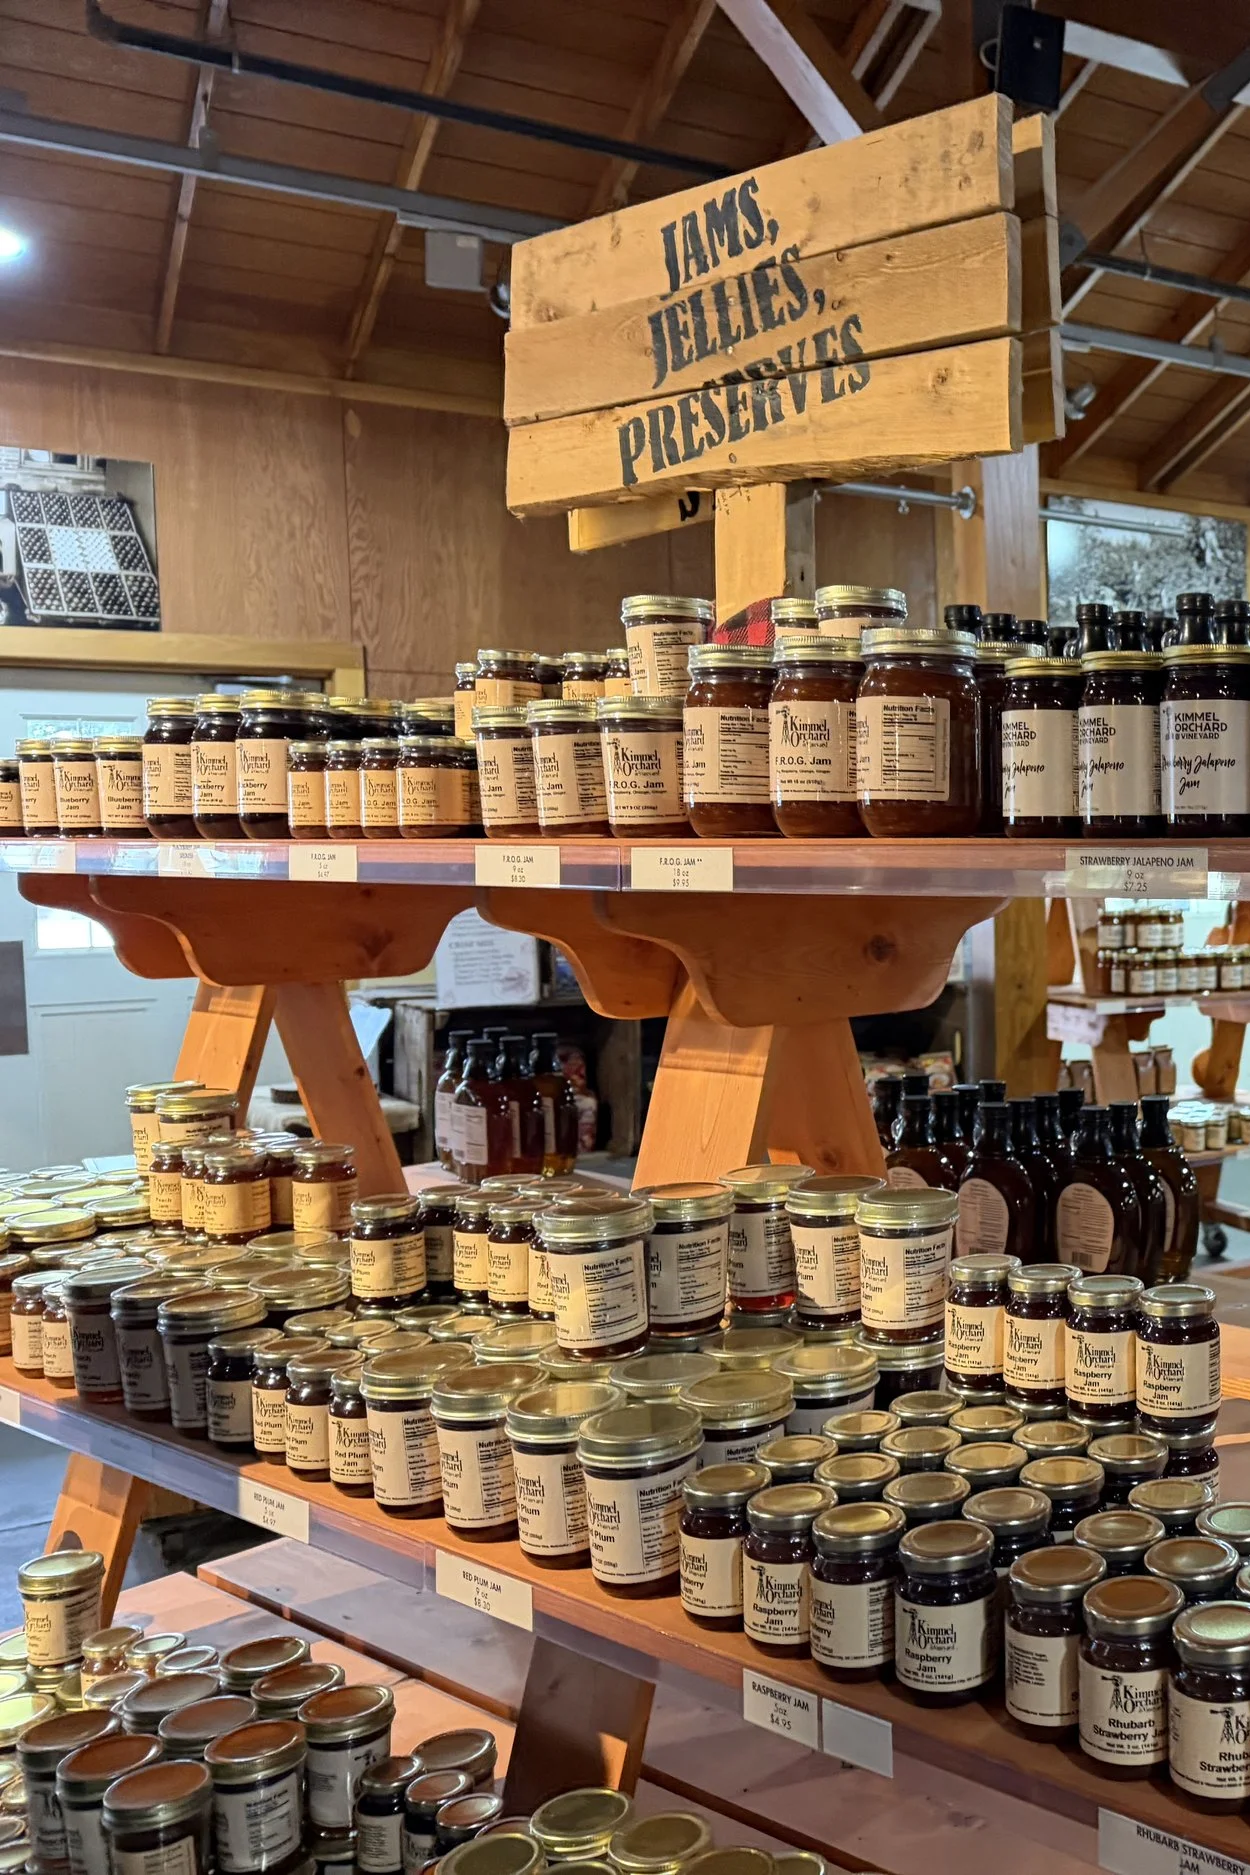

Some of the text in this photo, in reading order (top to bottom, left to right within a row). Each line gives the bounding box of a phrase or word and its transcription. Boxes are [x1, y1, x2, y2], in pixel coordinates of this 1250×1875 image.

[660, 177, 779, 292] JAMS,
[647, 244, 826, 389] JELLIES,
[617, 314, 871, 486] PRESERVES
[883, 704, 913, 712] Nutrition
[720, 714, 750, 722] Nutrition
[790, 716, 827, 731] Kimmel
[1175, 712, 1220, 722] KIMMEL
[1175, 723, 1228, 733] ORCHARD
[790, 729, 829, 747] Orchard
[622, 748, 658, 762] Kimmel
[810, 757, 831, 765] Jam
[623, 759, 661, 776] Orchard
[1194, 753, 1236, 774] Jalapeno
[1179, 777, 1200, 795] Jam
[659, 858, 682, 866] F.R.O.G.
[1080, 857, 1194, 867] STRAWBERRY JALAPENO JAM
[1124, 882, 1148, 892] $7.25
[678, 1242, 706, 1250] Nutrition
[905, 1246, 932, 1255] Nutrition
[584, 1256, 633, 1272] Nutrition Facts
[866, 1283, 883, 1293] Plum
[957, 1317, 982, 1330] Kimmel
[957, 1328, 984, 1341] Orchard
[1014, 1328, 1040, 1342] Kimmel
[1014, 1340, 1042, 1353] Orchard
[1084, 1343, 1114, 1356] Kimmel
[1085, 1354, 1115, 1368] Orchard
[1153, 1355, 1182, 1368] Kimmel
[1013, 1364, 1027, 1372] Jam
[1074, 1368, 1112, 1380] Raspberry
[1154, 1366, 1184, 1381] Orchard
[1143, 1380, 1181, 1393] Raspberry
[1152, 1392, 1169, 1400] Jam
[335, 1450, 346, 1458] Red
[639, 1484, 672, 1497] Nutrition
[521, 1504, 540, 1515] Plum
[594, 1530, 615, 1542] Plum
[463, 1571, 501, 1593] RED PLUM JAM
[766, 1576, 800, 1590] Kimmel
[766, 1586, 802, 1603] Orchard
[753, 1603, 798, 1617] Raspberry
[764, 1617, 783, 1626] Jam
[918, 1620, 954, 1635] Kimmel
[918, 1632, 956, 1650] Orchard
[905, 1648, 952, 1664] Raspberry
[917, 1663, 936, 1673] Jam
[752, 1681, 809, 1712] RASPBERRY JAM
[1108, 1718, 1155, 1728] Rhubarb
[1093, 1725, 1148, 1742] Strawberry
[1136, 1825, 1245, 1875] RHUBARB STRAWBERRY
[1180, 1857, 1199, 1873] JAM
